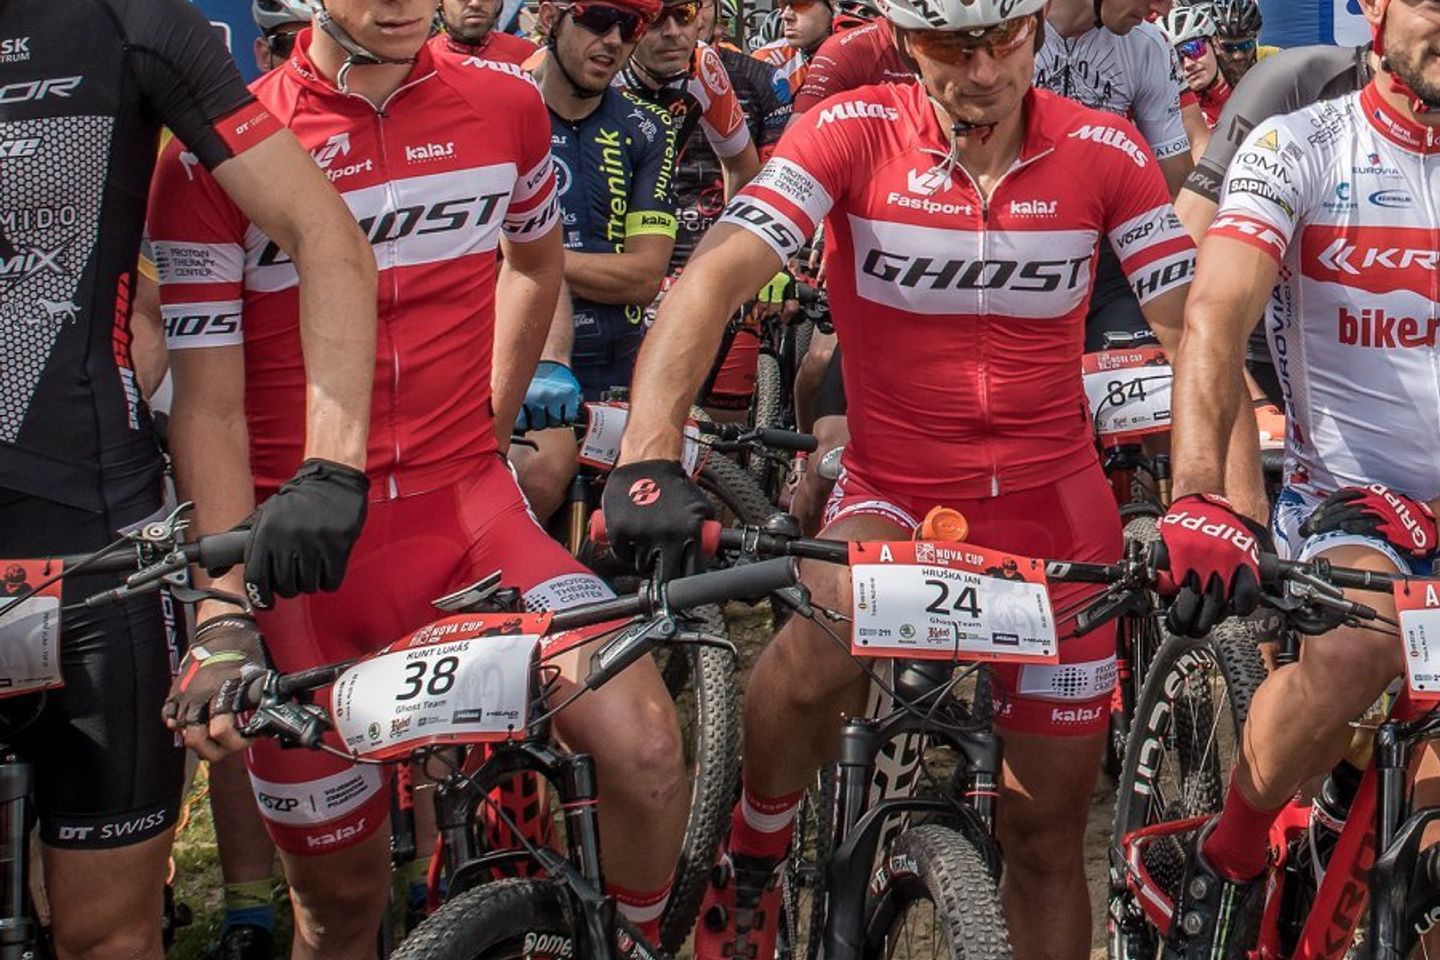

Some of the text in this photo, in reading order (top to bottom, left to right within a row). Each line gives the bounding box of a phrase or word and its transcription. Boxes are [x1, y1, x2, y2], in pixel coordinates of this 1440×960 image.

[815, 100, 899, 130] Mitas
[405, 141, 456, 161] kalas
[1067, 125, 1149, 168] Mitas
[887, 191, 972, 217] Fastport
[1010, 199, 1058, 214] kalas
[641, 214, 671, 227] kalas
[862, 247, 1095, 291] GHOST
[1107, 377, 1147, 406] 84
[879, 544, 893, 562] A
[936, 549, 984, 566] NOVA CUP
[922, 568, 981, 585] HRUŠKA JAN
[925, 579, 982, 619] 24
[1425, 583, 1440, 607] A
[432, 620, 484, 637] NOVA CUP
[395, 655, 460, 702] 38
[395, 698, 448, 714] Ghost Team
[1051, 706, 1102, 722] kalas
[100, 809, 166, 839] SWISS
[307, 817, 369, 847] kalas
